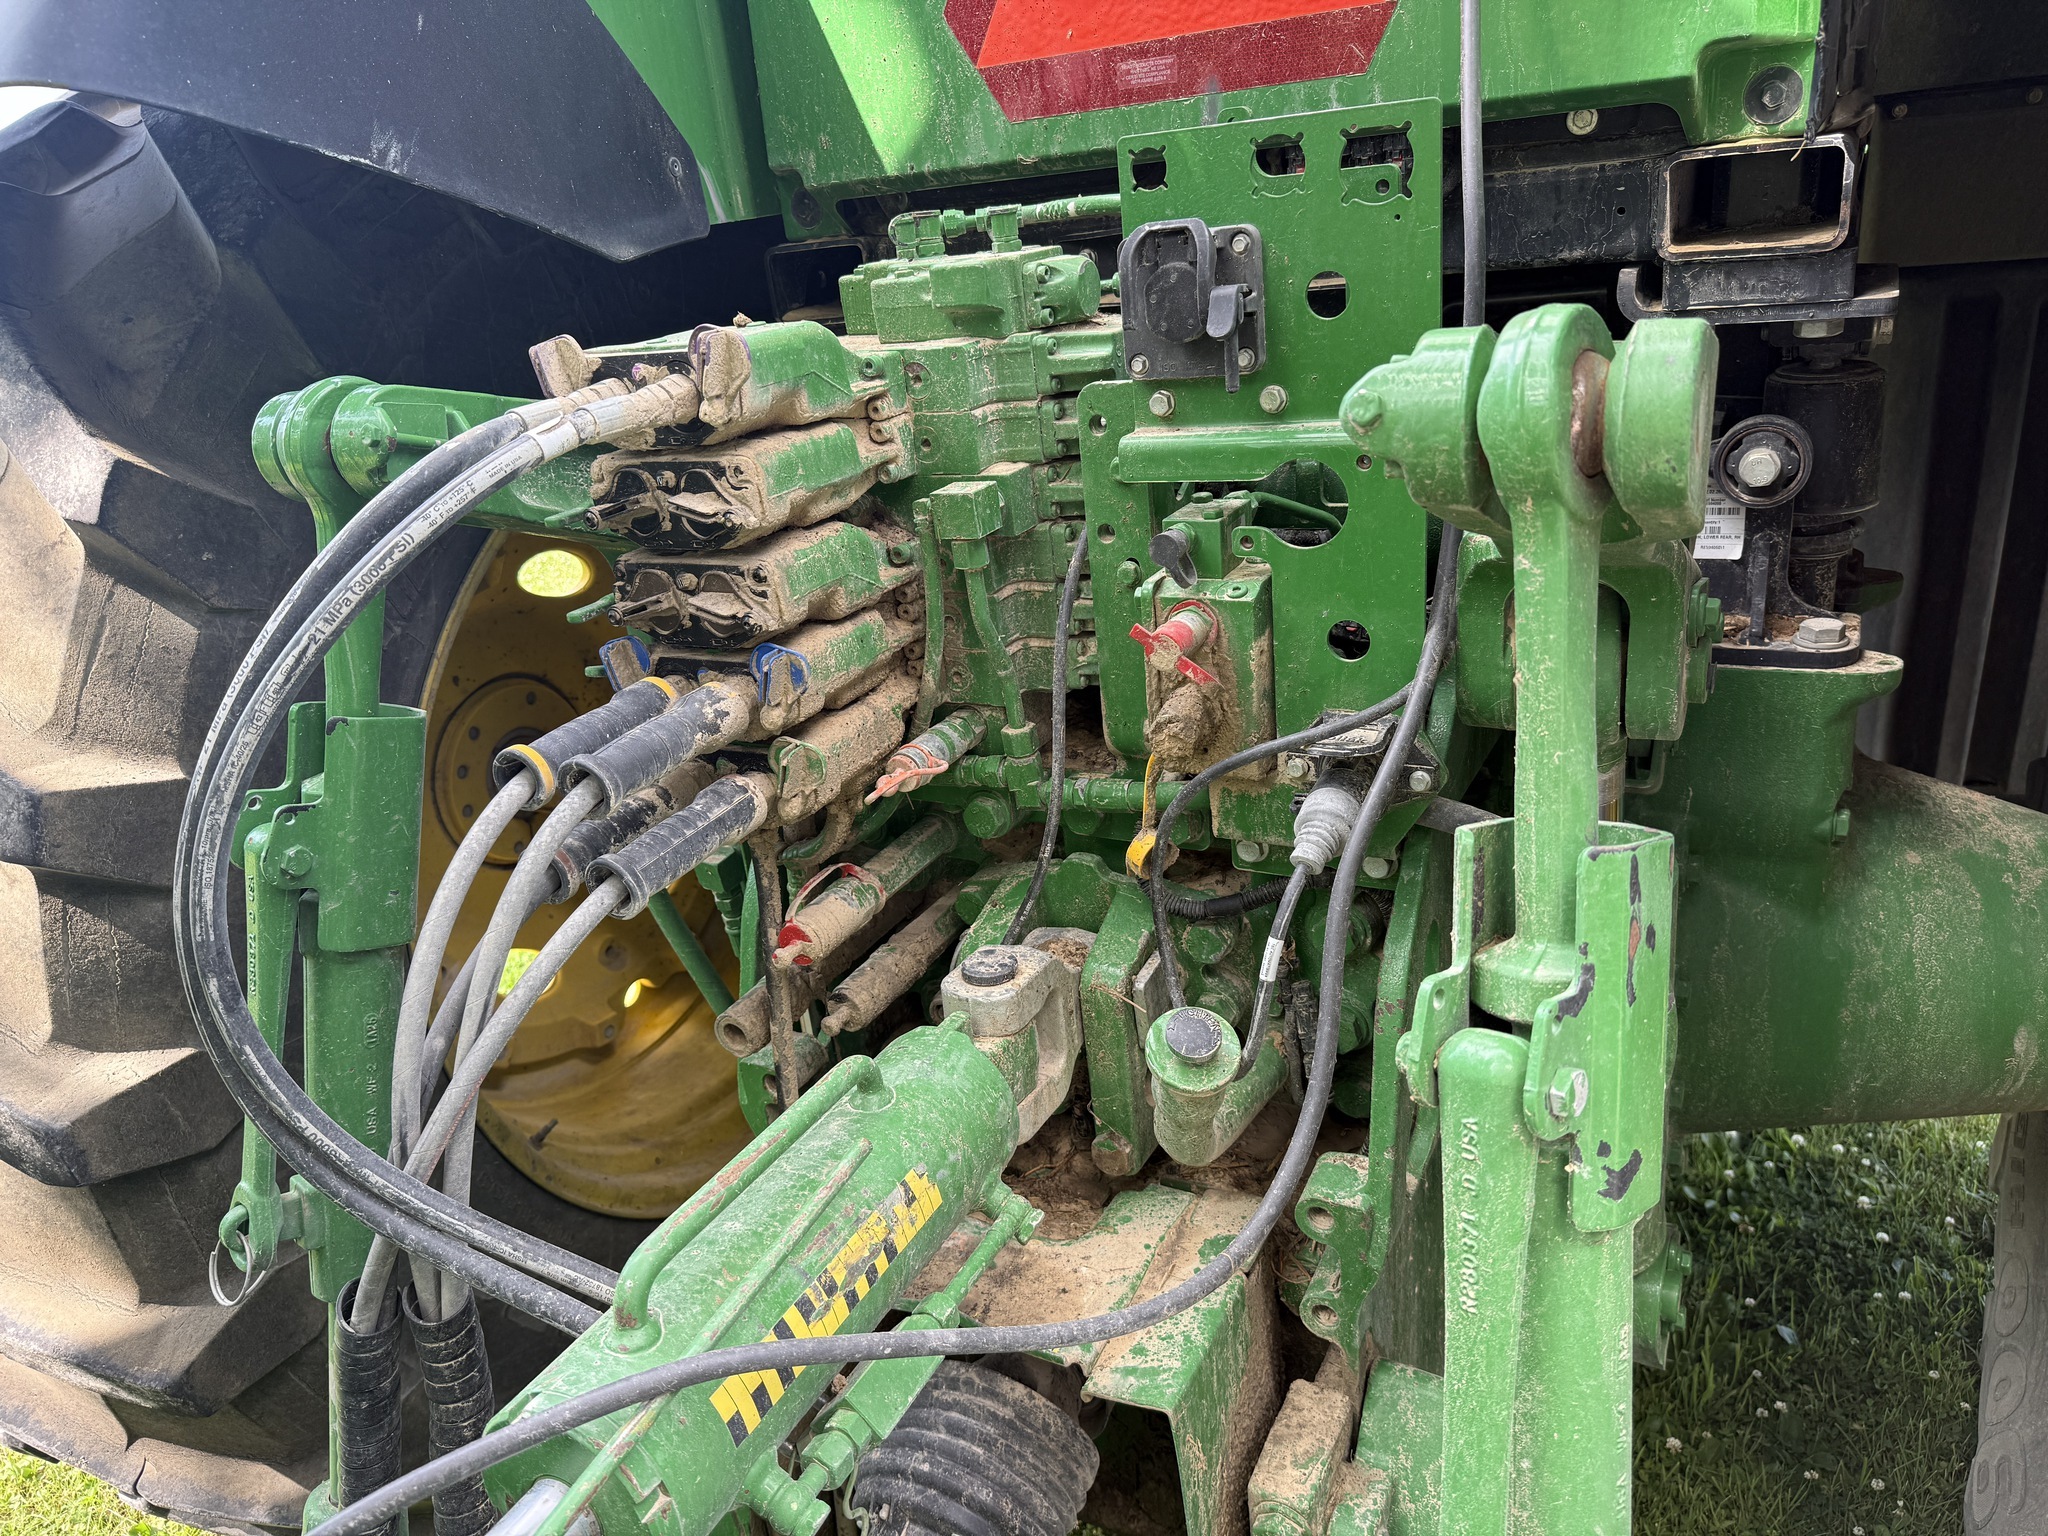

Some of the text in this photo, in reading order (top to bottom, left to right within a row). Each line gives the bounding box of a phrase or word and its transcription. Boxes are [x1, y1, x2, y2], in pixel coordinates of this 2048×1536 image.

[510, 455, 522, 465] USA
[307, 624, 326, 646] 21
[322, 597, 352, 627] MPa
[365, 1106, 378, 1136] USA
[1461, 1116, 1479, 1161] USA
